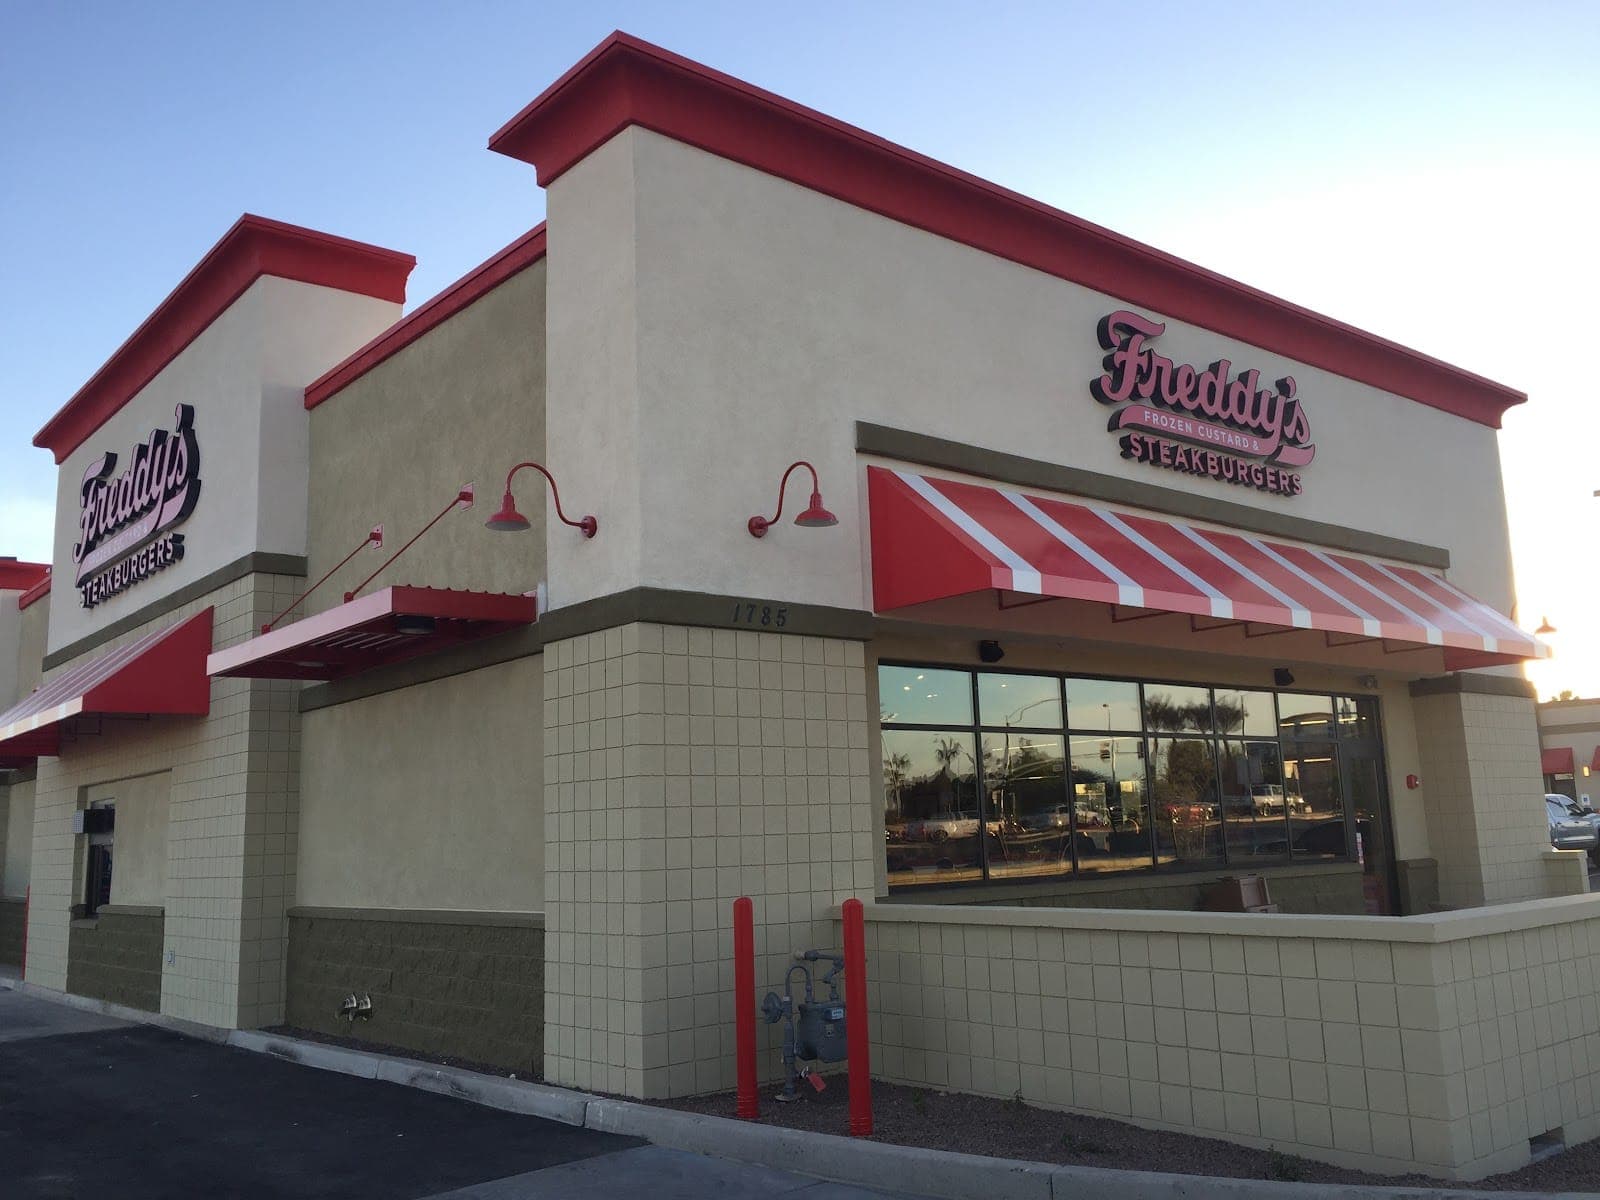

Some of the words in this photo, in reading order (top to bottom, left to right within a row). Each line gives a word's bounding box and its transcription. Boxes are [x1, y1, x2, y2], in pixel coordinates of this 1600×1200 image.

[1091, 310, 1312, 447] Freddy's
[1121, 432, 1303, 496] STEAKBURGERS
[1143, 410, 1193, 434] FROZEN
[1198, 425, 1249, 449] CUSTARD
[1252, 439, 1260, 451] &
[73, 403, 198, 563] Freddy's
[79, 533, 184, 608] STEAKBURGERS
[733, 603, 787, 627] 1785
